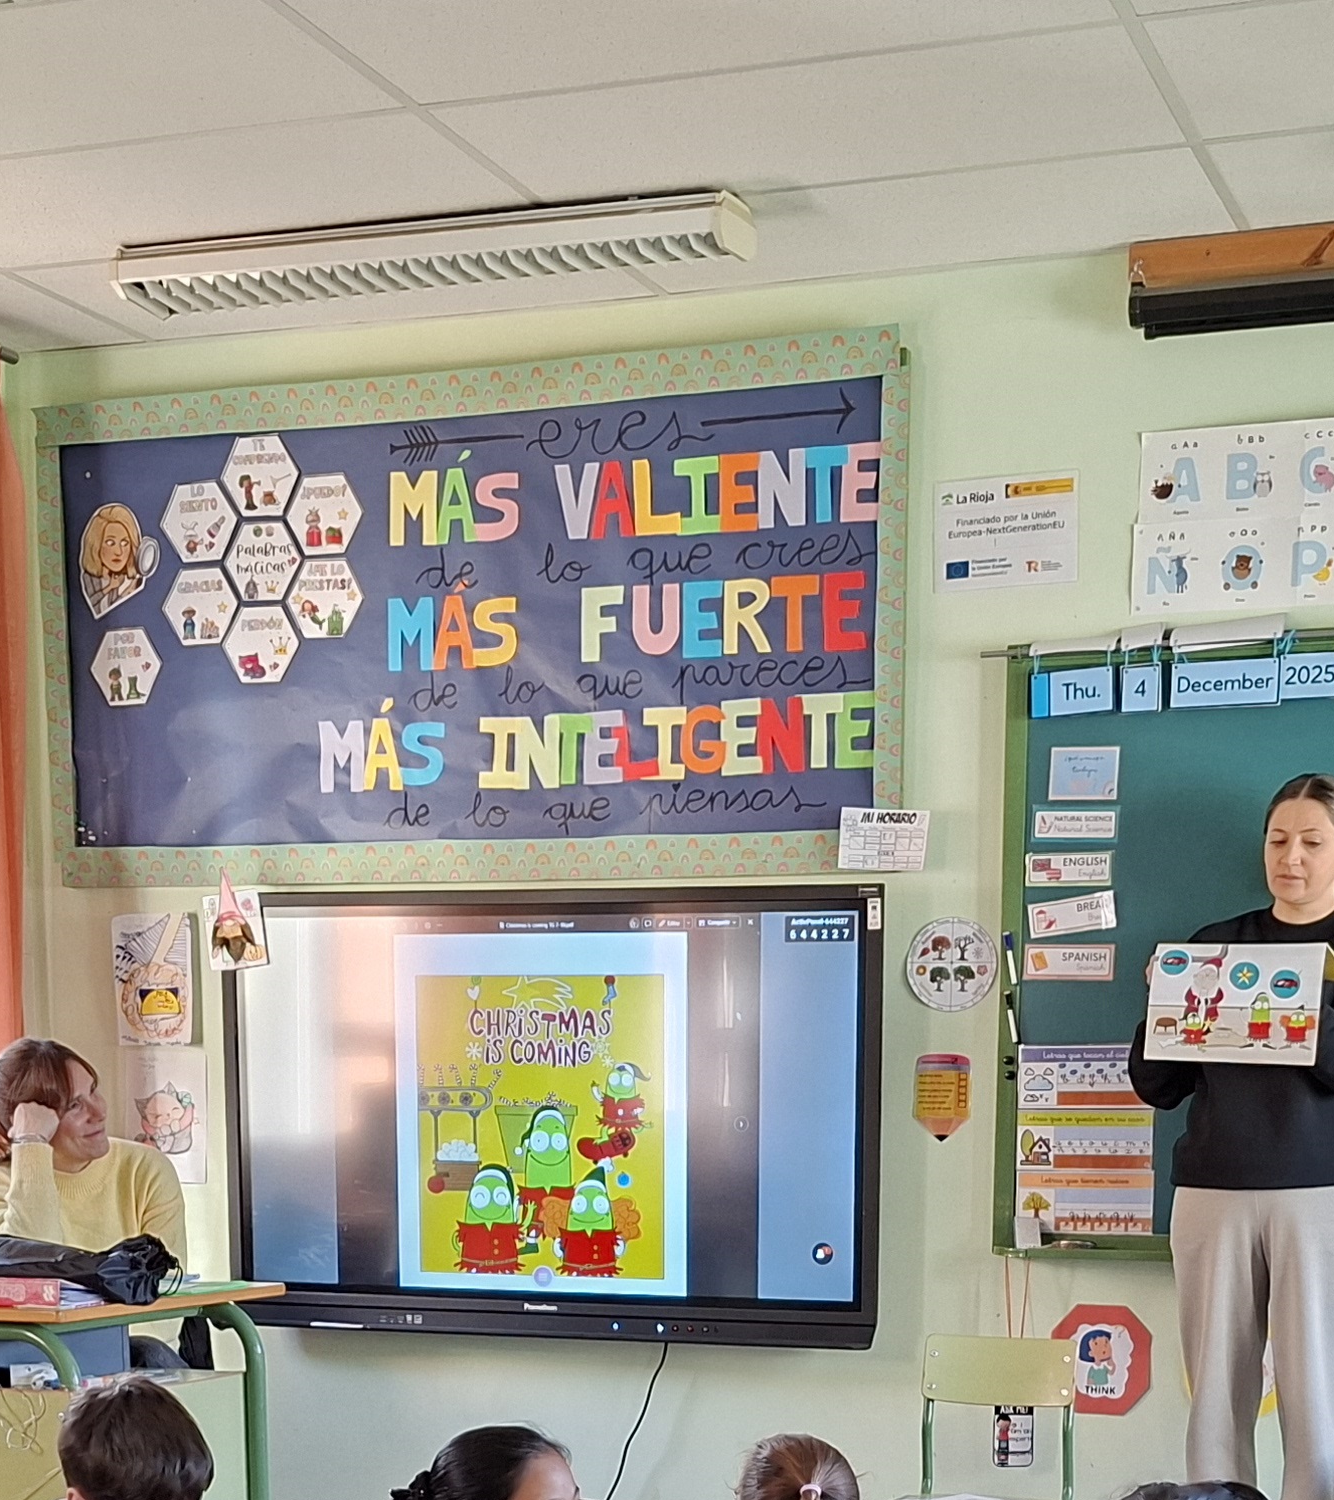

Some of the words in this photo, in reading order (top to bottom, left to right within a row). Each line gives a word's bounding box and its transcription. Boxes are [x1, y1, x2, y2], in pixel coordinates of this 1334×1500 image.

[525, 409, 715, 460] eres
[190, 485, 205, 497] LO
[389, 449, 519, 547] MÁS
[554, 441, 882, 540] VALIENTE
[956, 494, 967, 505] La
[969, 491, 995, 504] Rioja
[956, 515, 1001, 528] Financiado
[1003, 514, 1018, 524] por
[1020, 512, 1029, 521] la
[1031, 509, 1057, 520] Unión
[948, 520, 1065, 540] Europea-NextGenerationEU
[416, 548, 479, 590] de
[537, 543, 592, 584] lo
[627, 541, 713, 587] que
[736, 528, 878, 571] crees
[330, 563, 345, 575] LO
[177, 579, 223, 593] GRACIAS
[387, 582, 517, 671] MÁS
[580, 571, 868, 662] FUERTE
[407, 672, 460, 713] de
[498, 664, 545, 704] lo
[576, 664, 645, 704] que
[671, 655, 871, 701] pareces
[1062, 682, 1102, 700] Thu.
[1134, 679, 1147, 697] 4
[1176, 674, 1274, 694] December
[317, 697, 446, 793] MÁS
[478, 690, 874, 790] INTELIGENTE
[383, 792, 432, 829] de
[465, 788, 511, 828] lo
[542, 795, 611, 835] que
[640, 782, 827, 831] piensas
[860, 812, 875, 824] MI
[875, 812, 917, 825] HORARIO
[1062, 856, 1107, 866] ENGLISH
[1061, 952, 1107, 962] SPANISH
[1084, 1385, 1116, 1395] THINK
